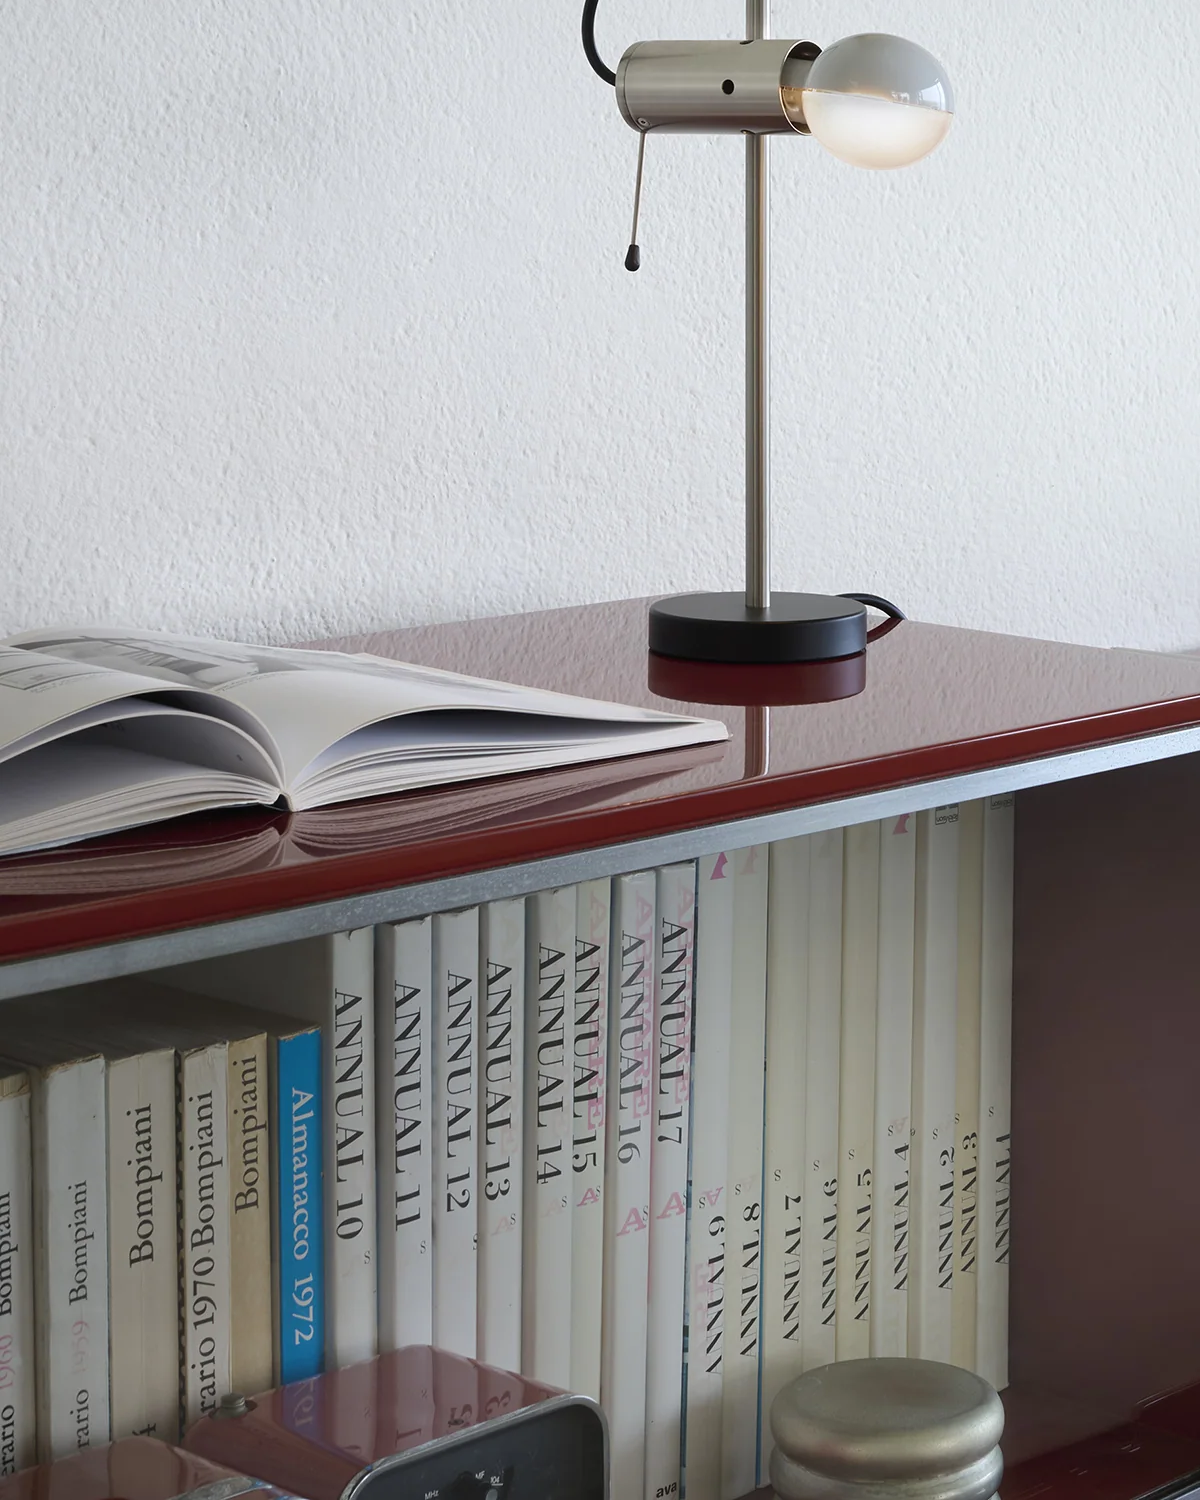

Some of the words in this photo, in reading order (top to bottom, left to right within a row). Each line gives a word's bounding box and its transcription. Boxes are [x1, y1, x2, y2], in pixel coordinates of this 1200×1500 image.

[446, 969, 473, 1159] ANNUAL
[485, 958, 512, 1145] ANNUAL
[536, 942, 566, 1128] ANNUAL
[573, 935, 601, 1119] ANNUAL
[618, 930, 646, 1111] ANNUAL
[658, 917, 688, 1095] ANNUAL
[232, 1055, 267, 1214] Bompiani
[334, 988, 364, 1183] ANNUAL
[394, 980, 422, 1174] ANNUAL
[657, 1105, 684, 1145] 17
[126, 1103, 163, 1268] Bompiani
[189, 1090, 223, 1252] Bompiani
[291, 1087, 315, 1260] Almanacco
[446, 1167, 471, 1212] 12
[484, 1156, 511, 1201] 13
[536, 1140, 563, 1185] 14
[572, 1130, 598, 1174] 15
[617, 1120, 642, 1165] 16
[822, 1177, 838, 1198] 6
[856, 1168, 872, 1187] 5
[894, 1142, 910, 1161] 4
[939, 1146, 956, 1167] 2
[962, 1131, 978, 1151] 3
[995, 1133, 1011, 1143] 1
[0, 1191, 19, 1316] Bompiani
[68, 1180, 95, 1306] Bompiani
[335, 1193, 364, 1240] 10
[395, 1184, 421, 1231] 11
[708, 1214, 726, 1238] 9
[742, 1202, 760, 1222] 8
[784, 1194, 802, 1211] 7
[854, 1194, 872, 1321] ANNUAL
[893, 1170, 910, 1291] ANNUAL
[938, 1170, 954, 1290] ANNUAL
[960, 1156, 978, 1273] ANNUAL
[994, 1147, 1012, 1265] ANNUAL
[191, 1256, 218, 1330] 1970
[291, 1273, 315, 1345] 1972
[705, 1243, 726, 1375] ANNUAL
[740, 1228, 760, 1358] ANNUAL
[783, 1216, 802, 1342] ANNUAL
[821, 1203, 838, 1327] ANNUAL
[424, 1489, 440, 1500] MHz
[655, 1481, 678, 1499] ava
